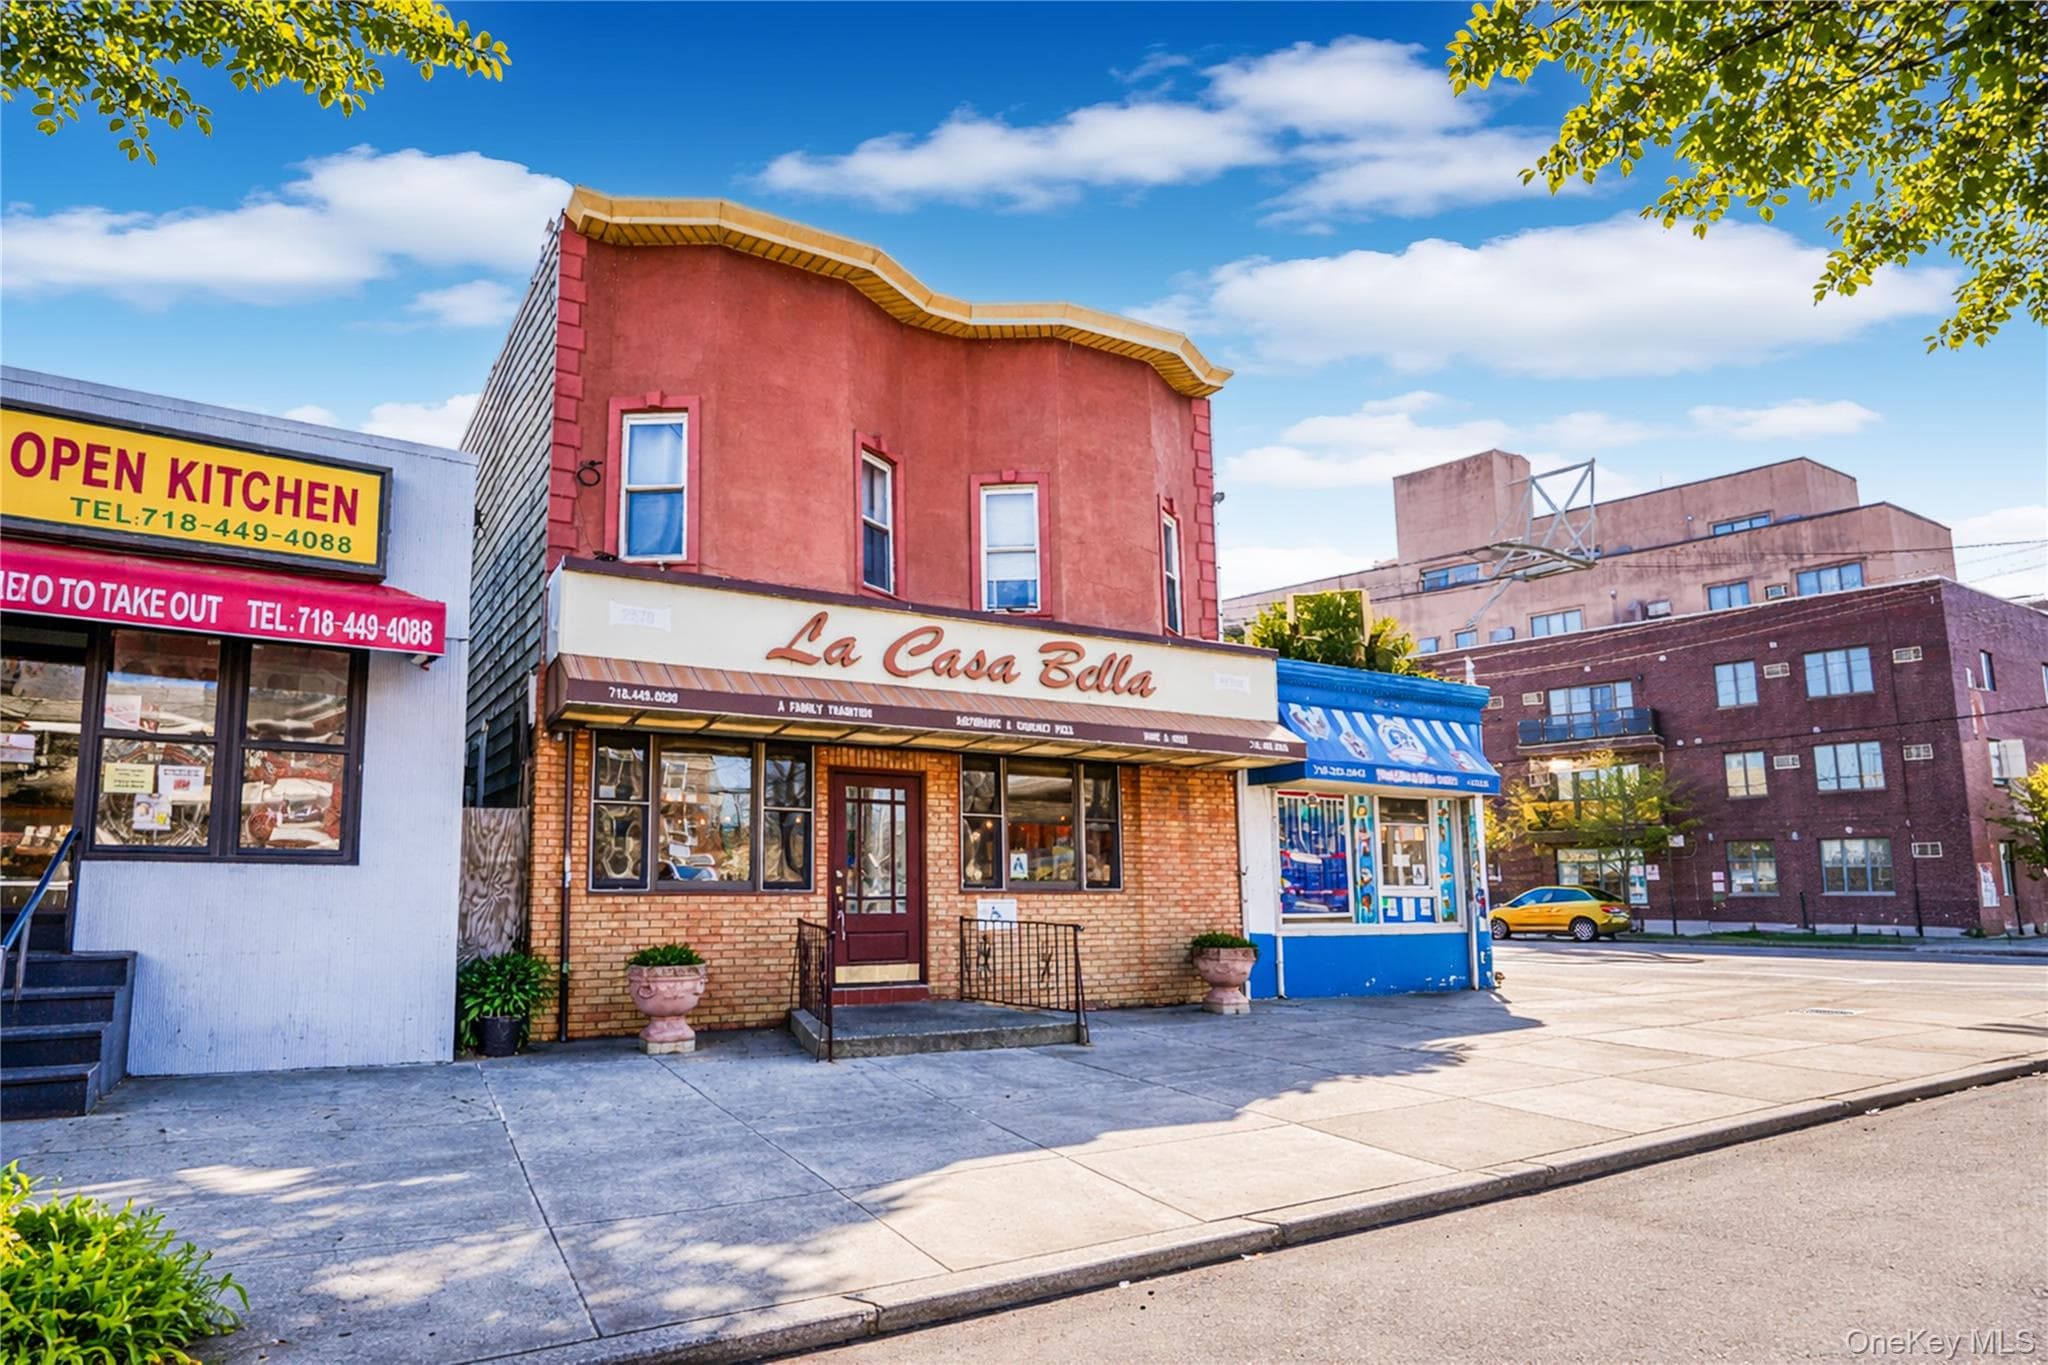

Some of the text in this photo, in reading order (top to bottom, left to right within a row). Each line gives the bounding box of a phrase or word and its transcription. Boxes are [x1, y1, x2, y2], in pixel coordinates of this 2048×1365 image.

[11, 431, 359, 526] OPEN KITCHEN
[59, 577, 96, 611] TO
[100, 582, 167, 618] TAKE
[170, 591, 223, 624] OUT
[766, 611, 1158, 697] La Casa Bella
[777, 700, 785, 713] A
